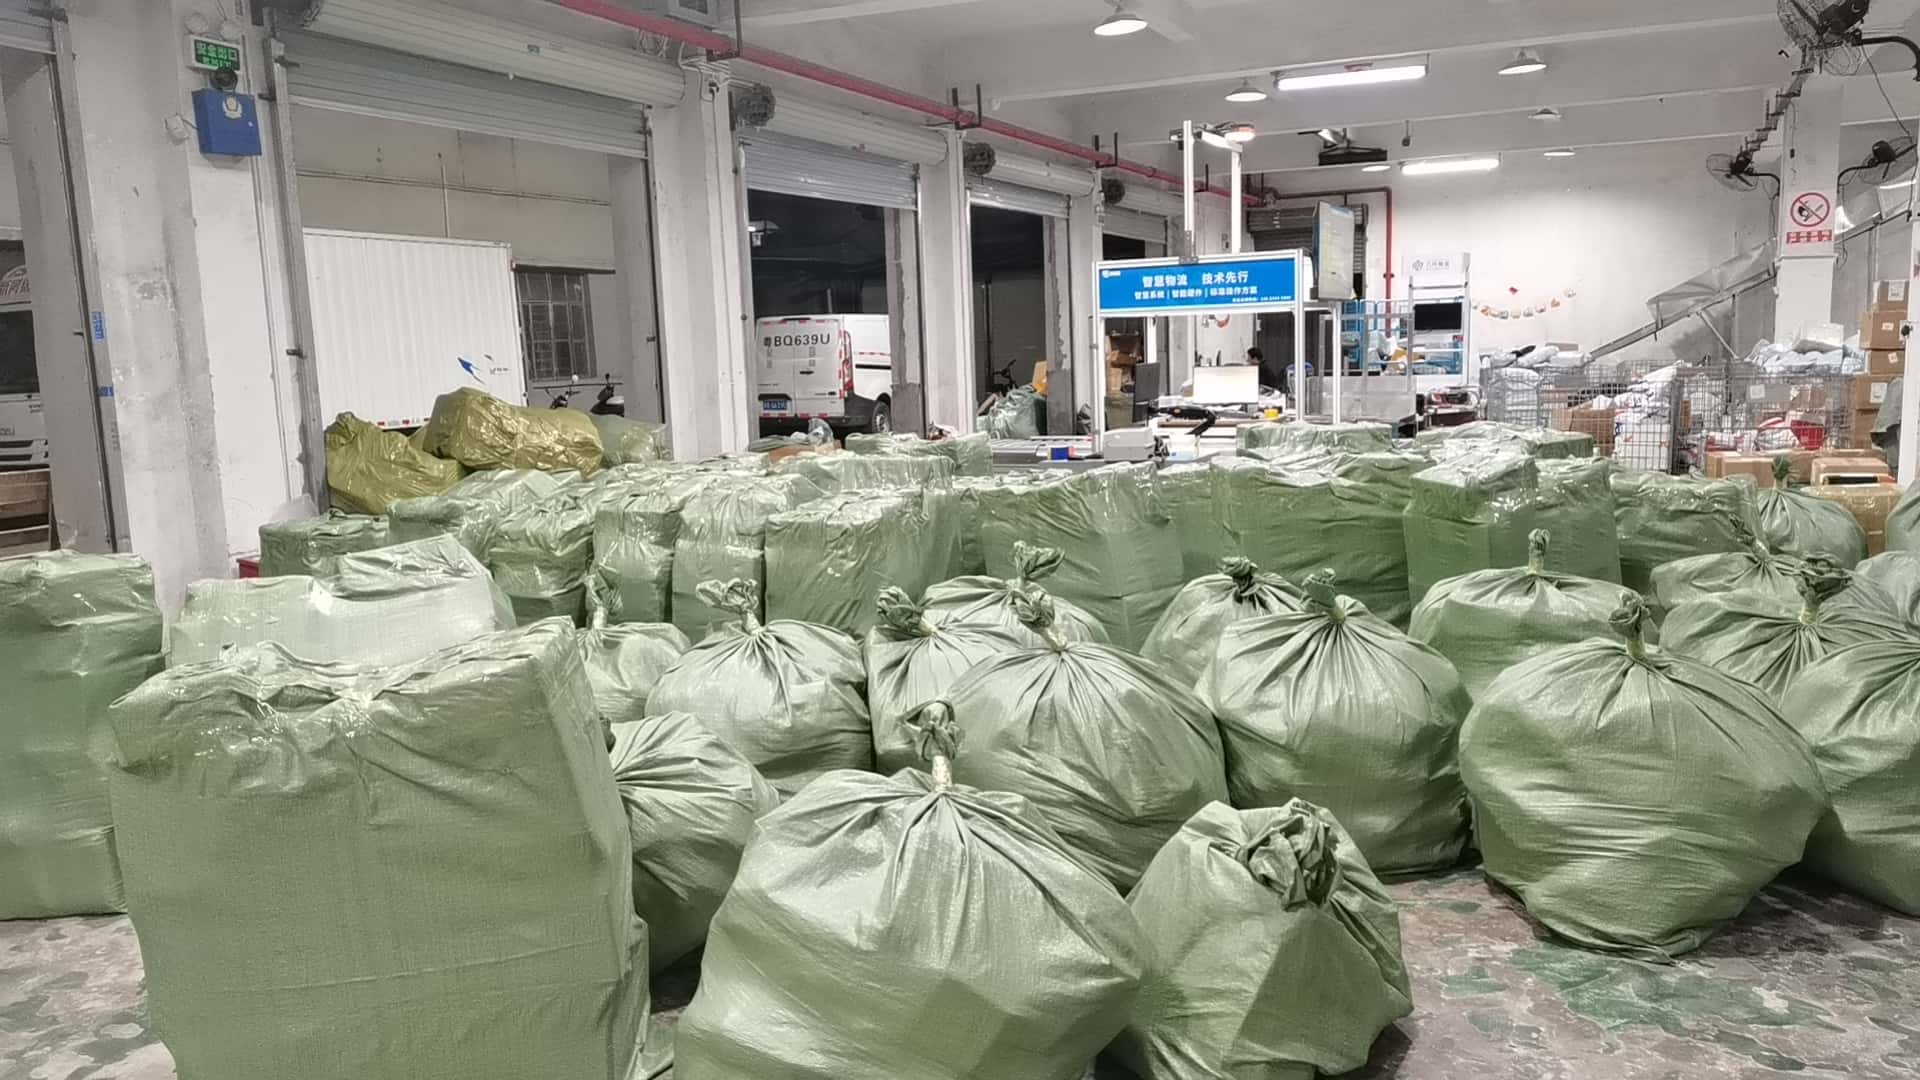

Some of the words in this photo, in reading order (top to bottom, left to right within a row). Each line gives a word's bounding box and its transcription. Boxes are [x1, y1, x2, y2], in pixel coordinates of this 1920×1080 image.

[1142, 273, 1188, 288] 智慧物流
[1202, 271, 1248, 285] 技术先行
